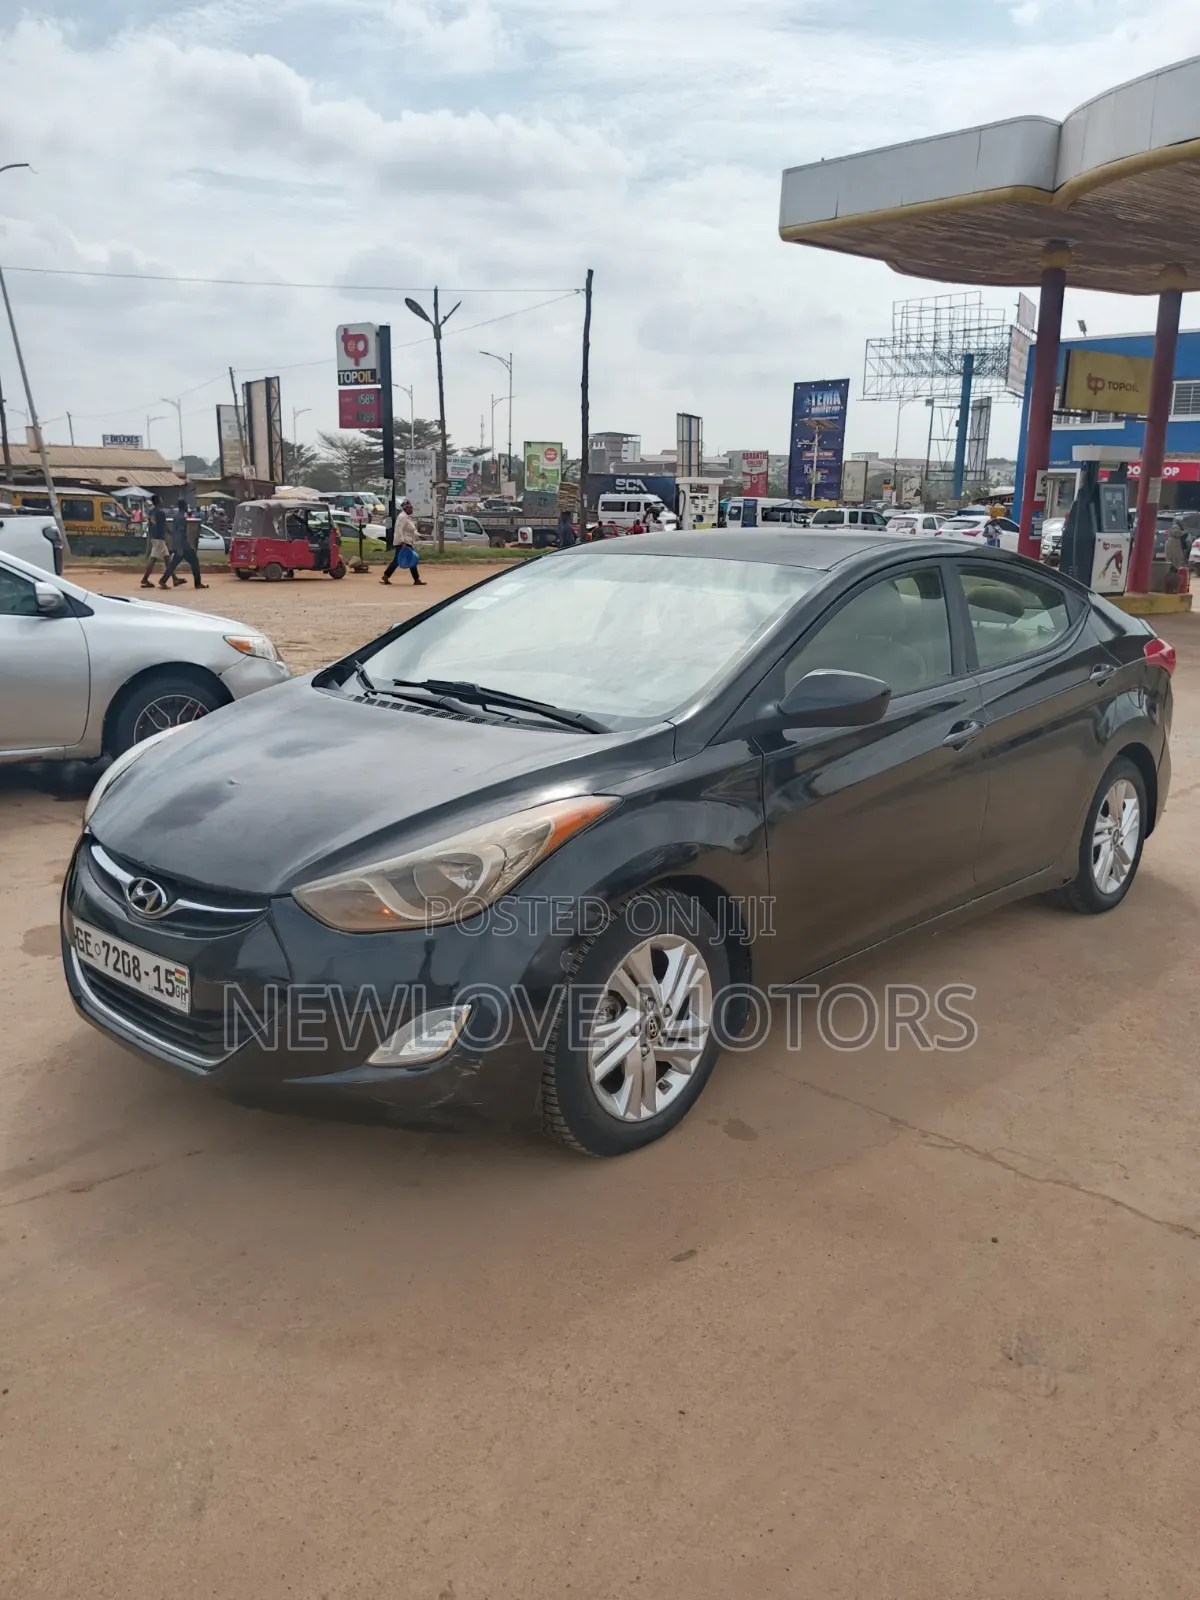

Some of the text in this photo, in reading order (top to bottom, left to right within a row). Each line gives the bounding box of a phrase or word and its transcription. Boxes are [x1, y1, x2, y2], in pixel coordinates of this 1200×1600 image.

[339, 371, 374, 384] TOPOIL
[1108, 381, 1139, 392] TOPOIL
[811, 390, 841, 406] TEMA
[75, 926, 175, 998] GE 7208-15
[176, 985, 187, 1002] GH
